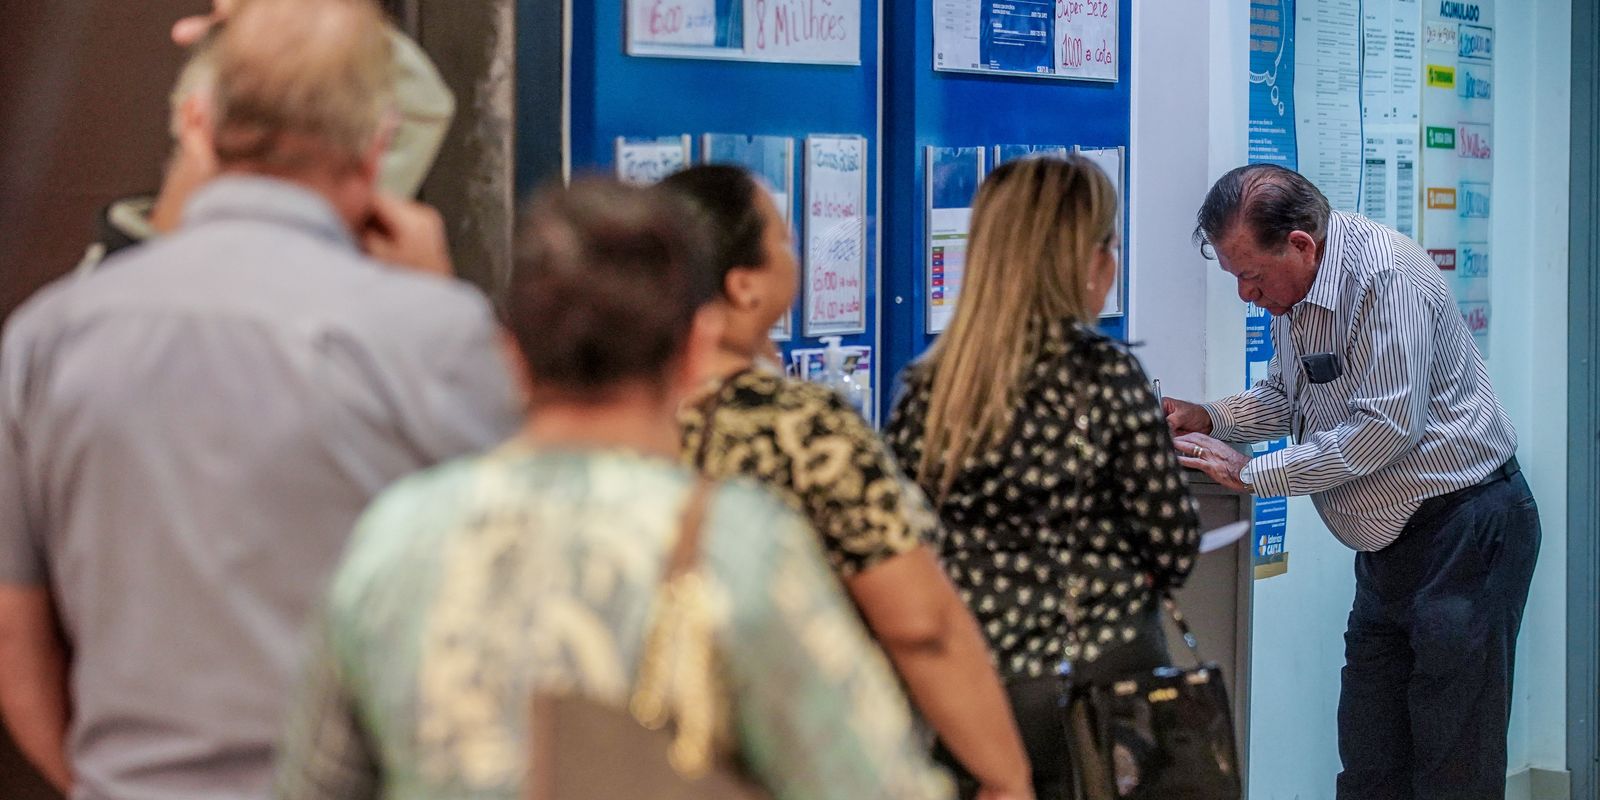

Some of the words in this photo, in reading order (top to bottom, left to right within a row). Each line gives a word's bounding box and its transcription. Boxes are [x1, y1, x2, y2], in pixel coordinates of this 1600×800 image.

[1056, 0, 1084, 23] Super
[1087, 0, 1108, 18] Sete
[1440, 0, 1480, 22] ACUMULADO
[756, 0, 766, 49] 8
[774, 0, 846, 46] Milhões
[1085, 49, 1092, 61] a
[1095, 39, 1112, 65] cota
